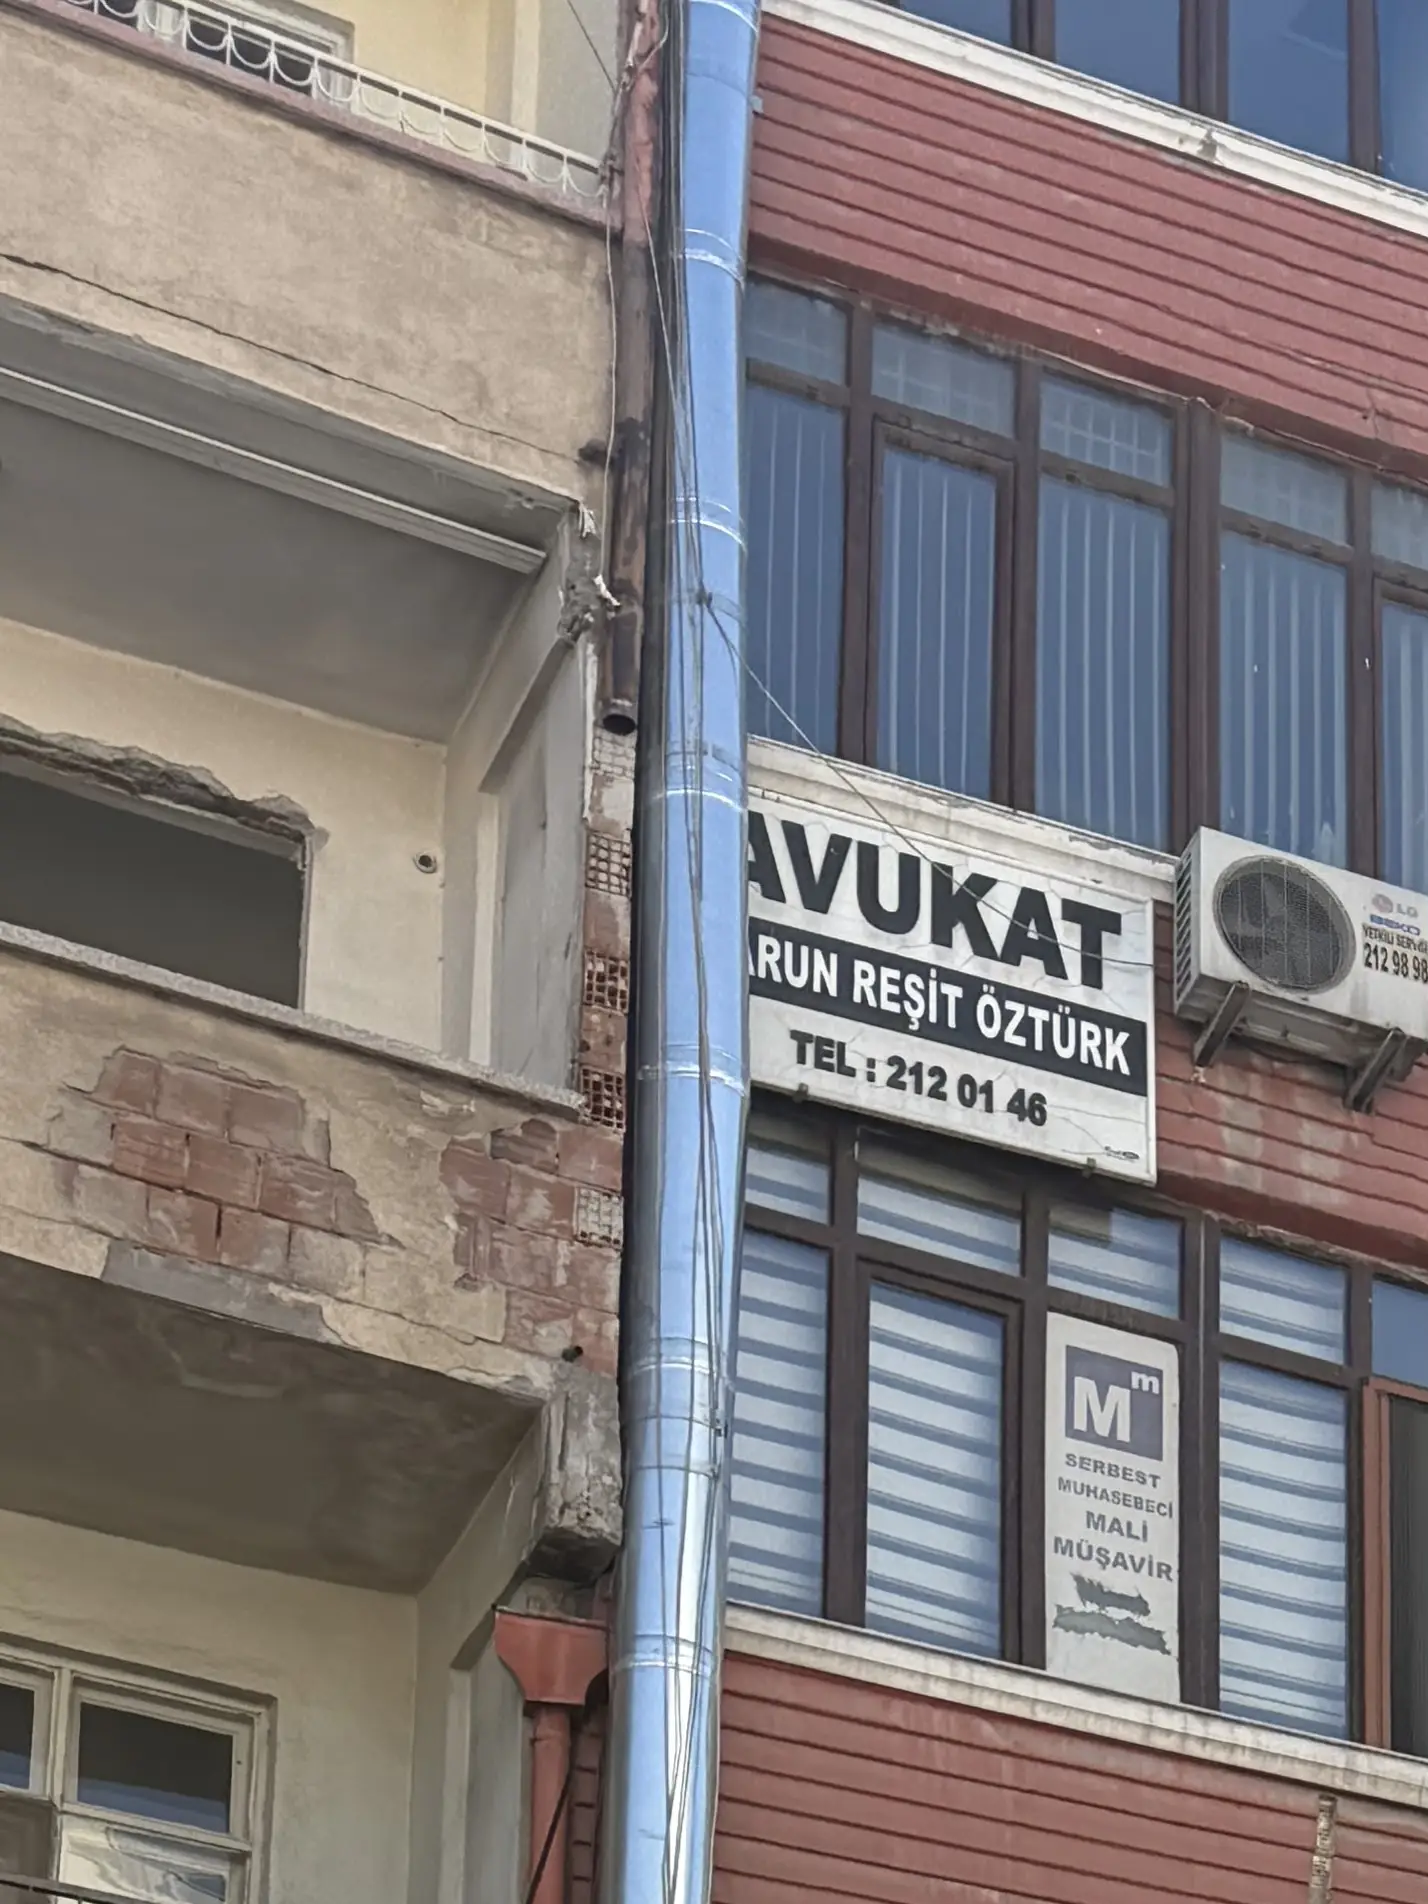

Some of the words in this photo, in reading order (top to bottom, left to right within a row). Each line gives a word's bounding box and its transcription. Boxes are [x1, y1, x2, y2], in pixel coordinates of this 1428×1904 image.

[853, 961, 963, 1031] REŞİT
[975, 984, 1131, 1077] ÖZTÜRK
[886, 1055, 948, 1102] 212
[958, 1073, 995, 1114] 01
[1007, 1087, 1048, 1127] 46
[1065, 1452, 1161, 1490] SERBEST
[1057, 1476, 1173, 1520] MUHASEBECİ
[1085, 1510, 1149, 1544] MALİ
[1053, 1536, 1173, 1583] MÜŞAVİR
